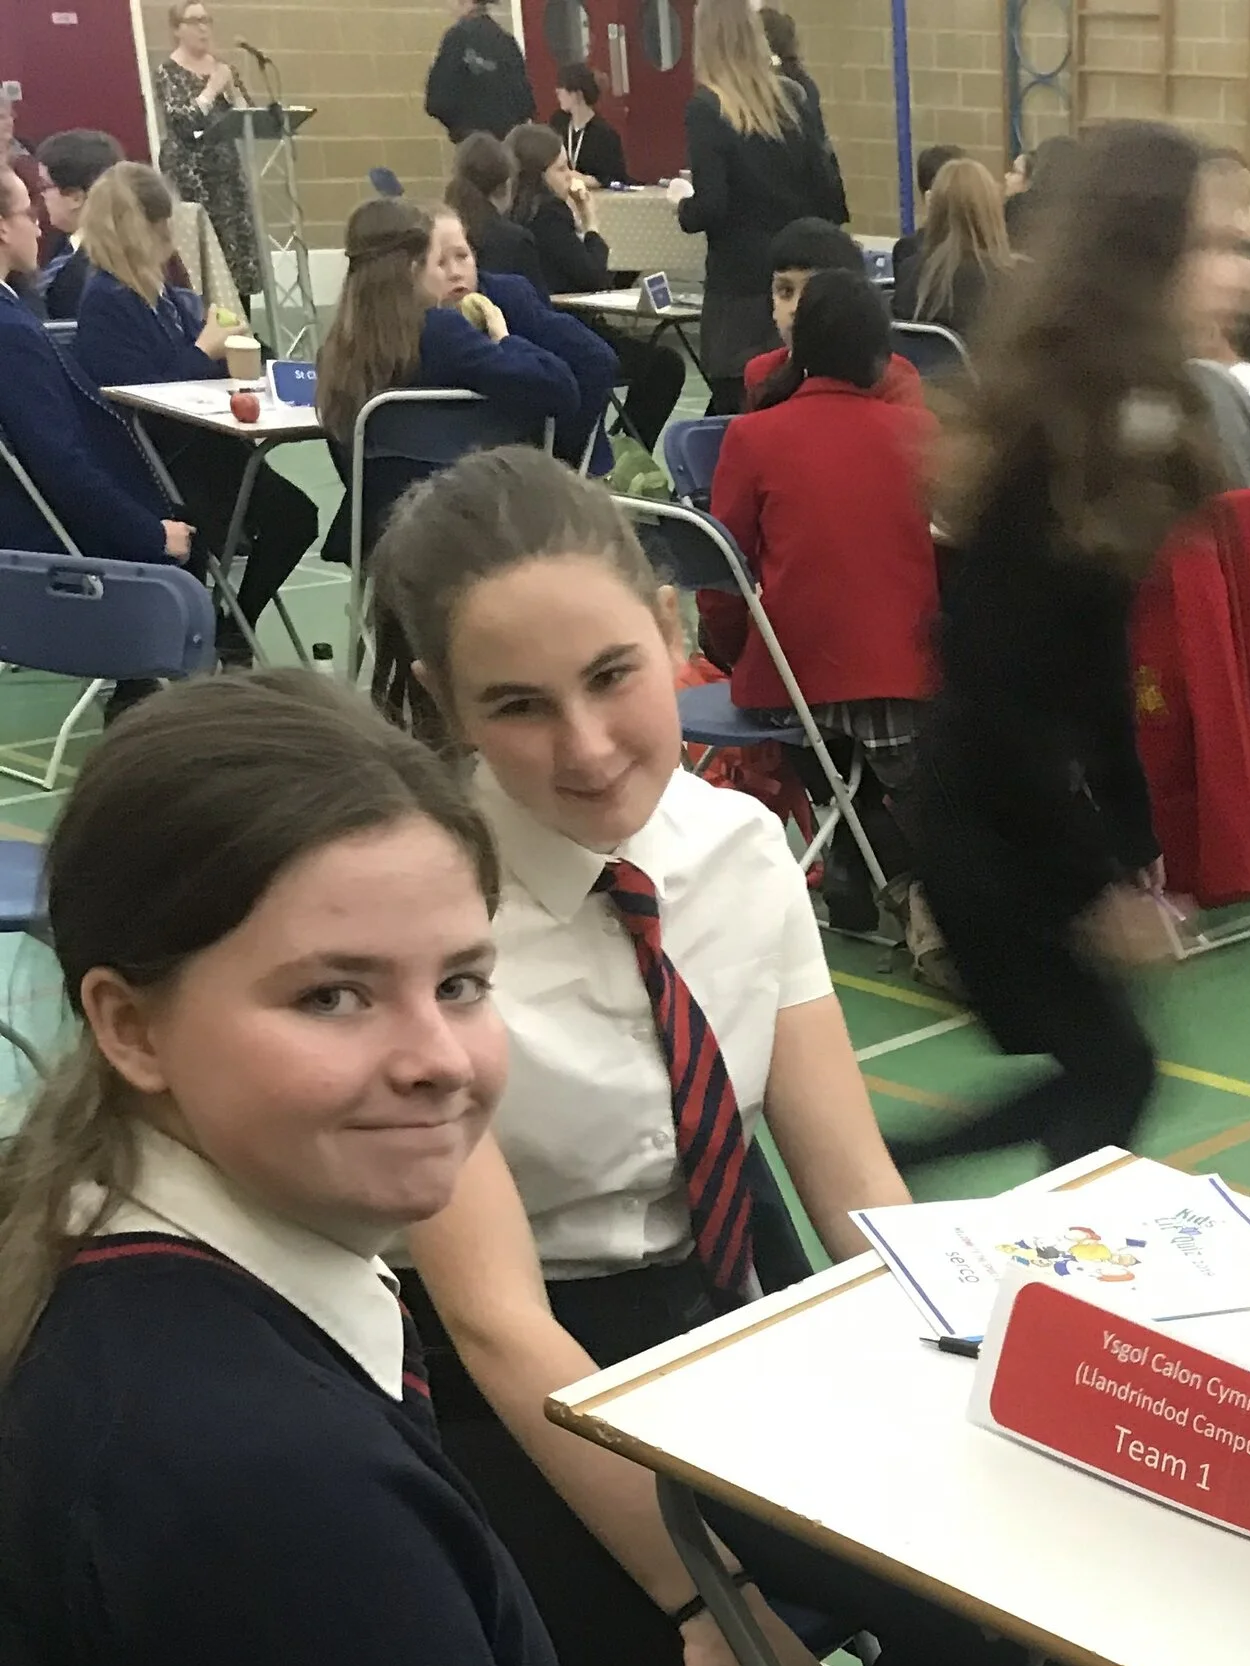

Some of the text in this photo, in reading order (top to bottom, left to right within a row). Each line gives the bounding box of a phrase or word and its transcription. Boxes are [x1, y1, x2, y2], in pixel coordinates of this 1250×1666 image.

[945, 1251, 980, 1283] serco
[1103, 1330, 1150, 1366] Ysgol
[1151, 1353, 1202, 1390] Calon
[1075, 1361, 1190, 1427] (Llandrindod
[1114, 1424, 1211, 1491] Team 1
